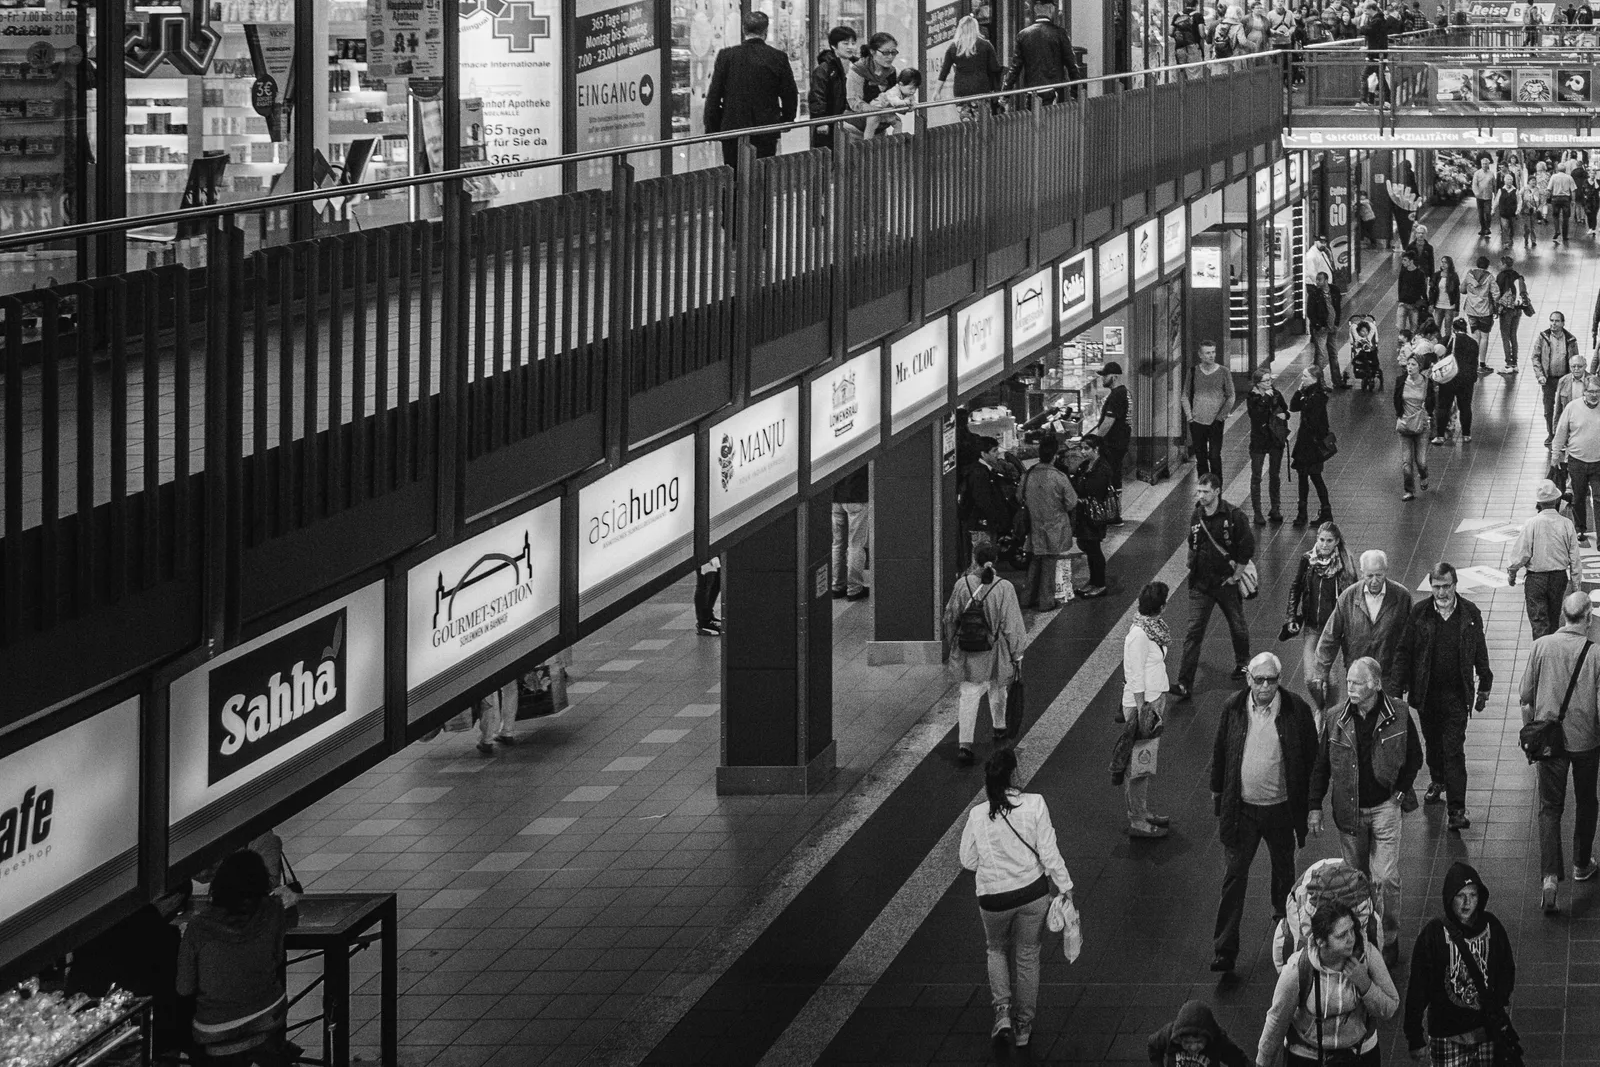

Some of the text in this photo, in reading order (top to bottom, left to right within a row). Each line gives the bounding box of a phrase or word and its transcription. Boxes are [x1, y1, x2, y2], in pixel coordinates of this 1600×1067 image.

[604, 13, 620, 28] Tage
[578, 81, 636, 107] EINGANG
[485, 124, 541, 137] 65 Tagen
[494, 138, 509, 147] für
[513, 138, 530, 146] Sie
[533, 138, 547, 146] da
[1330, 203, 1347, 227] GO
[896, 362, 910, 385] Mr.
[739, 418, 785, 467] MANJU
[588, 476, 679, 544] asiahung
[433, 580, 533, 647] GOURMET-STATION
[220, 660, 337, 755] Sahha
[0, 785, 54, 863] afe
[0, 844, 52, 878] eeshop
